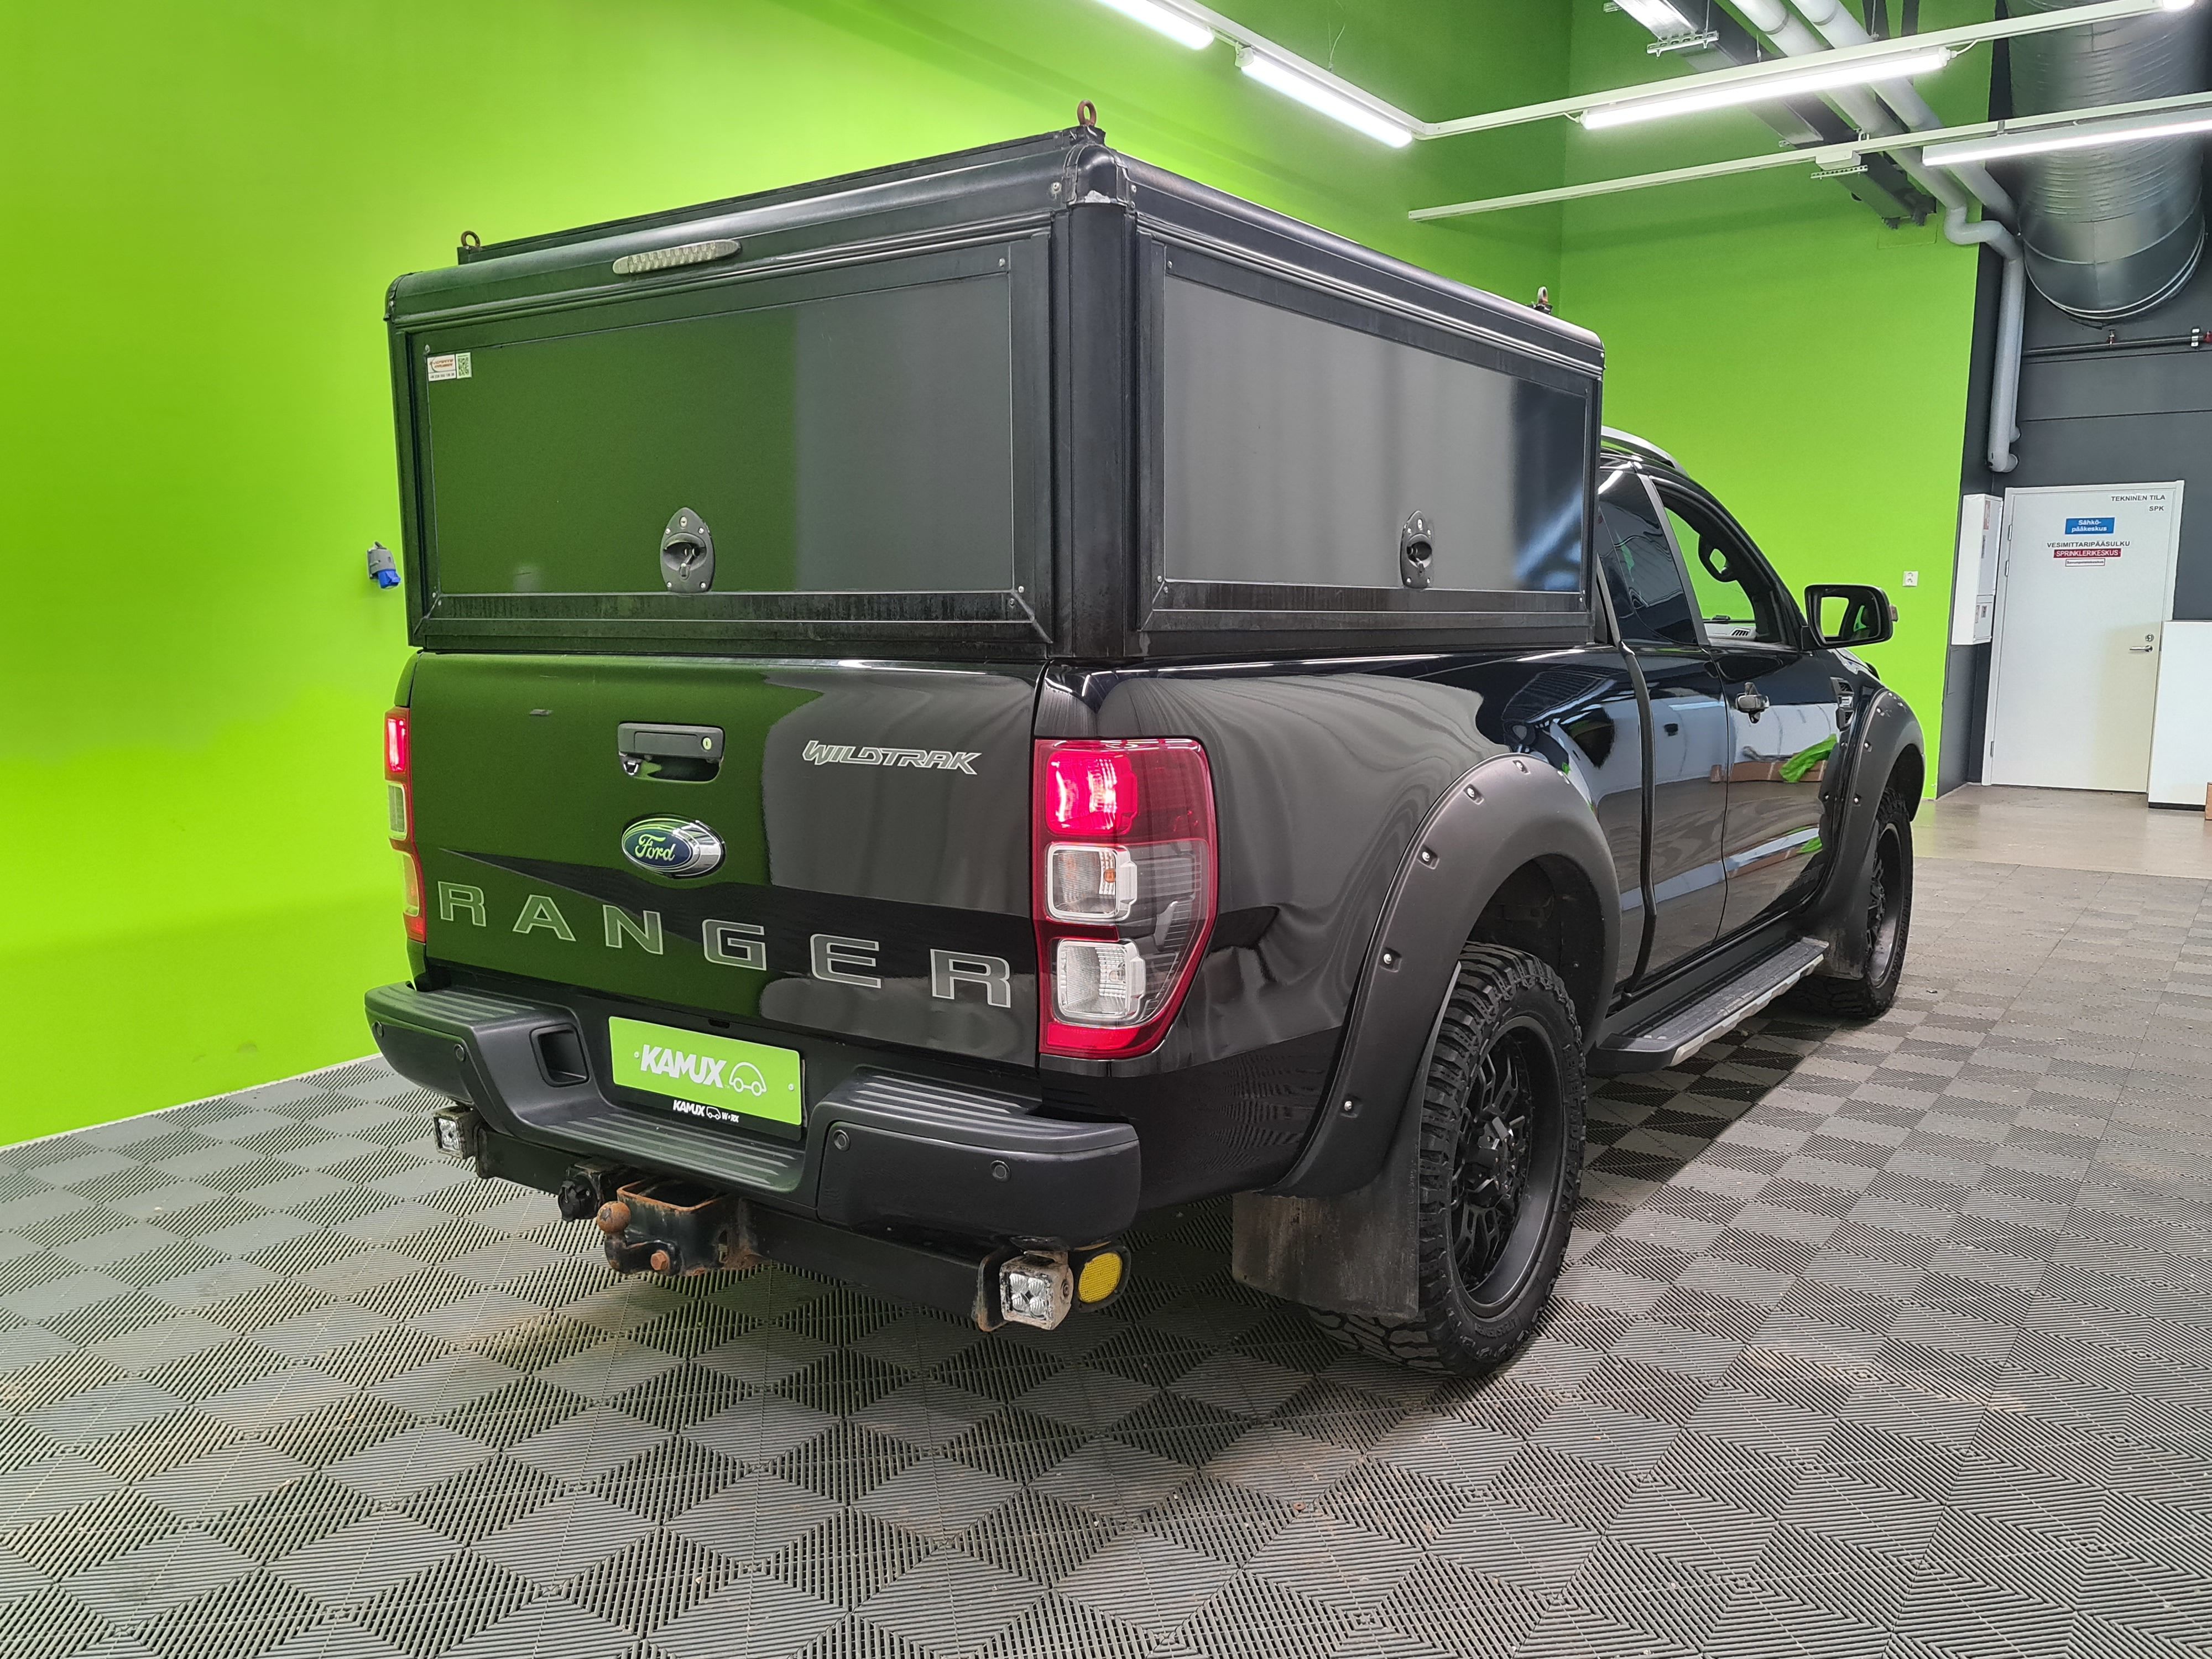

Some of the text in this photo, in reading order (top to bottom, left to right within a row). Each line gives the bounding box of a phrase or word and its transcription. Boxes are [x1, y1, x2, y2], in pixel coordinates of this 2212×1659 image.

[802, 740, 983, 775] WILDTRAK
[634, 832, 676, 863] Ford
[437, 880, 1012, 1008] RANGER
[640, 1044, 728, 1089] KAMUX
[672, 1099, 706, 1117] KAMUX
